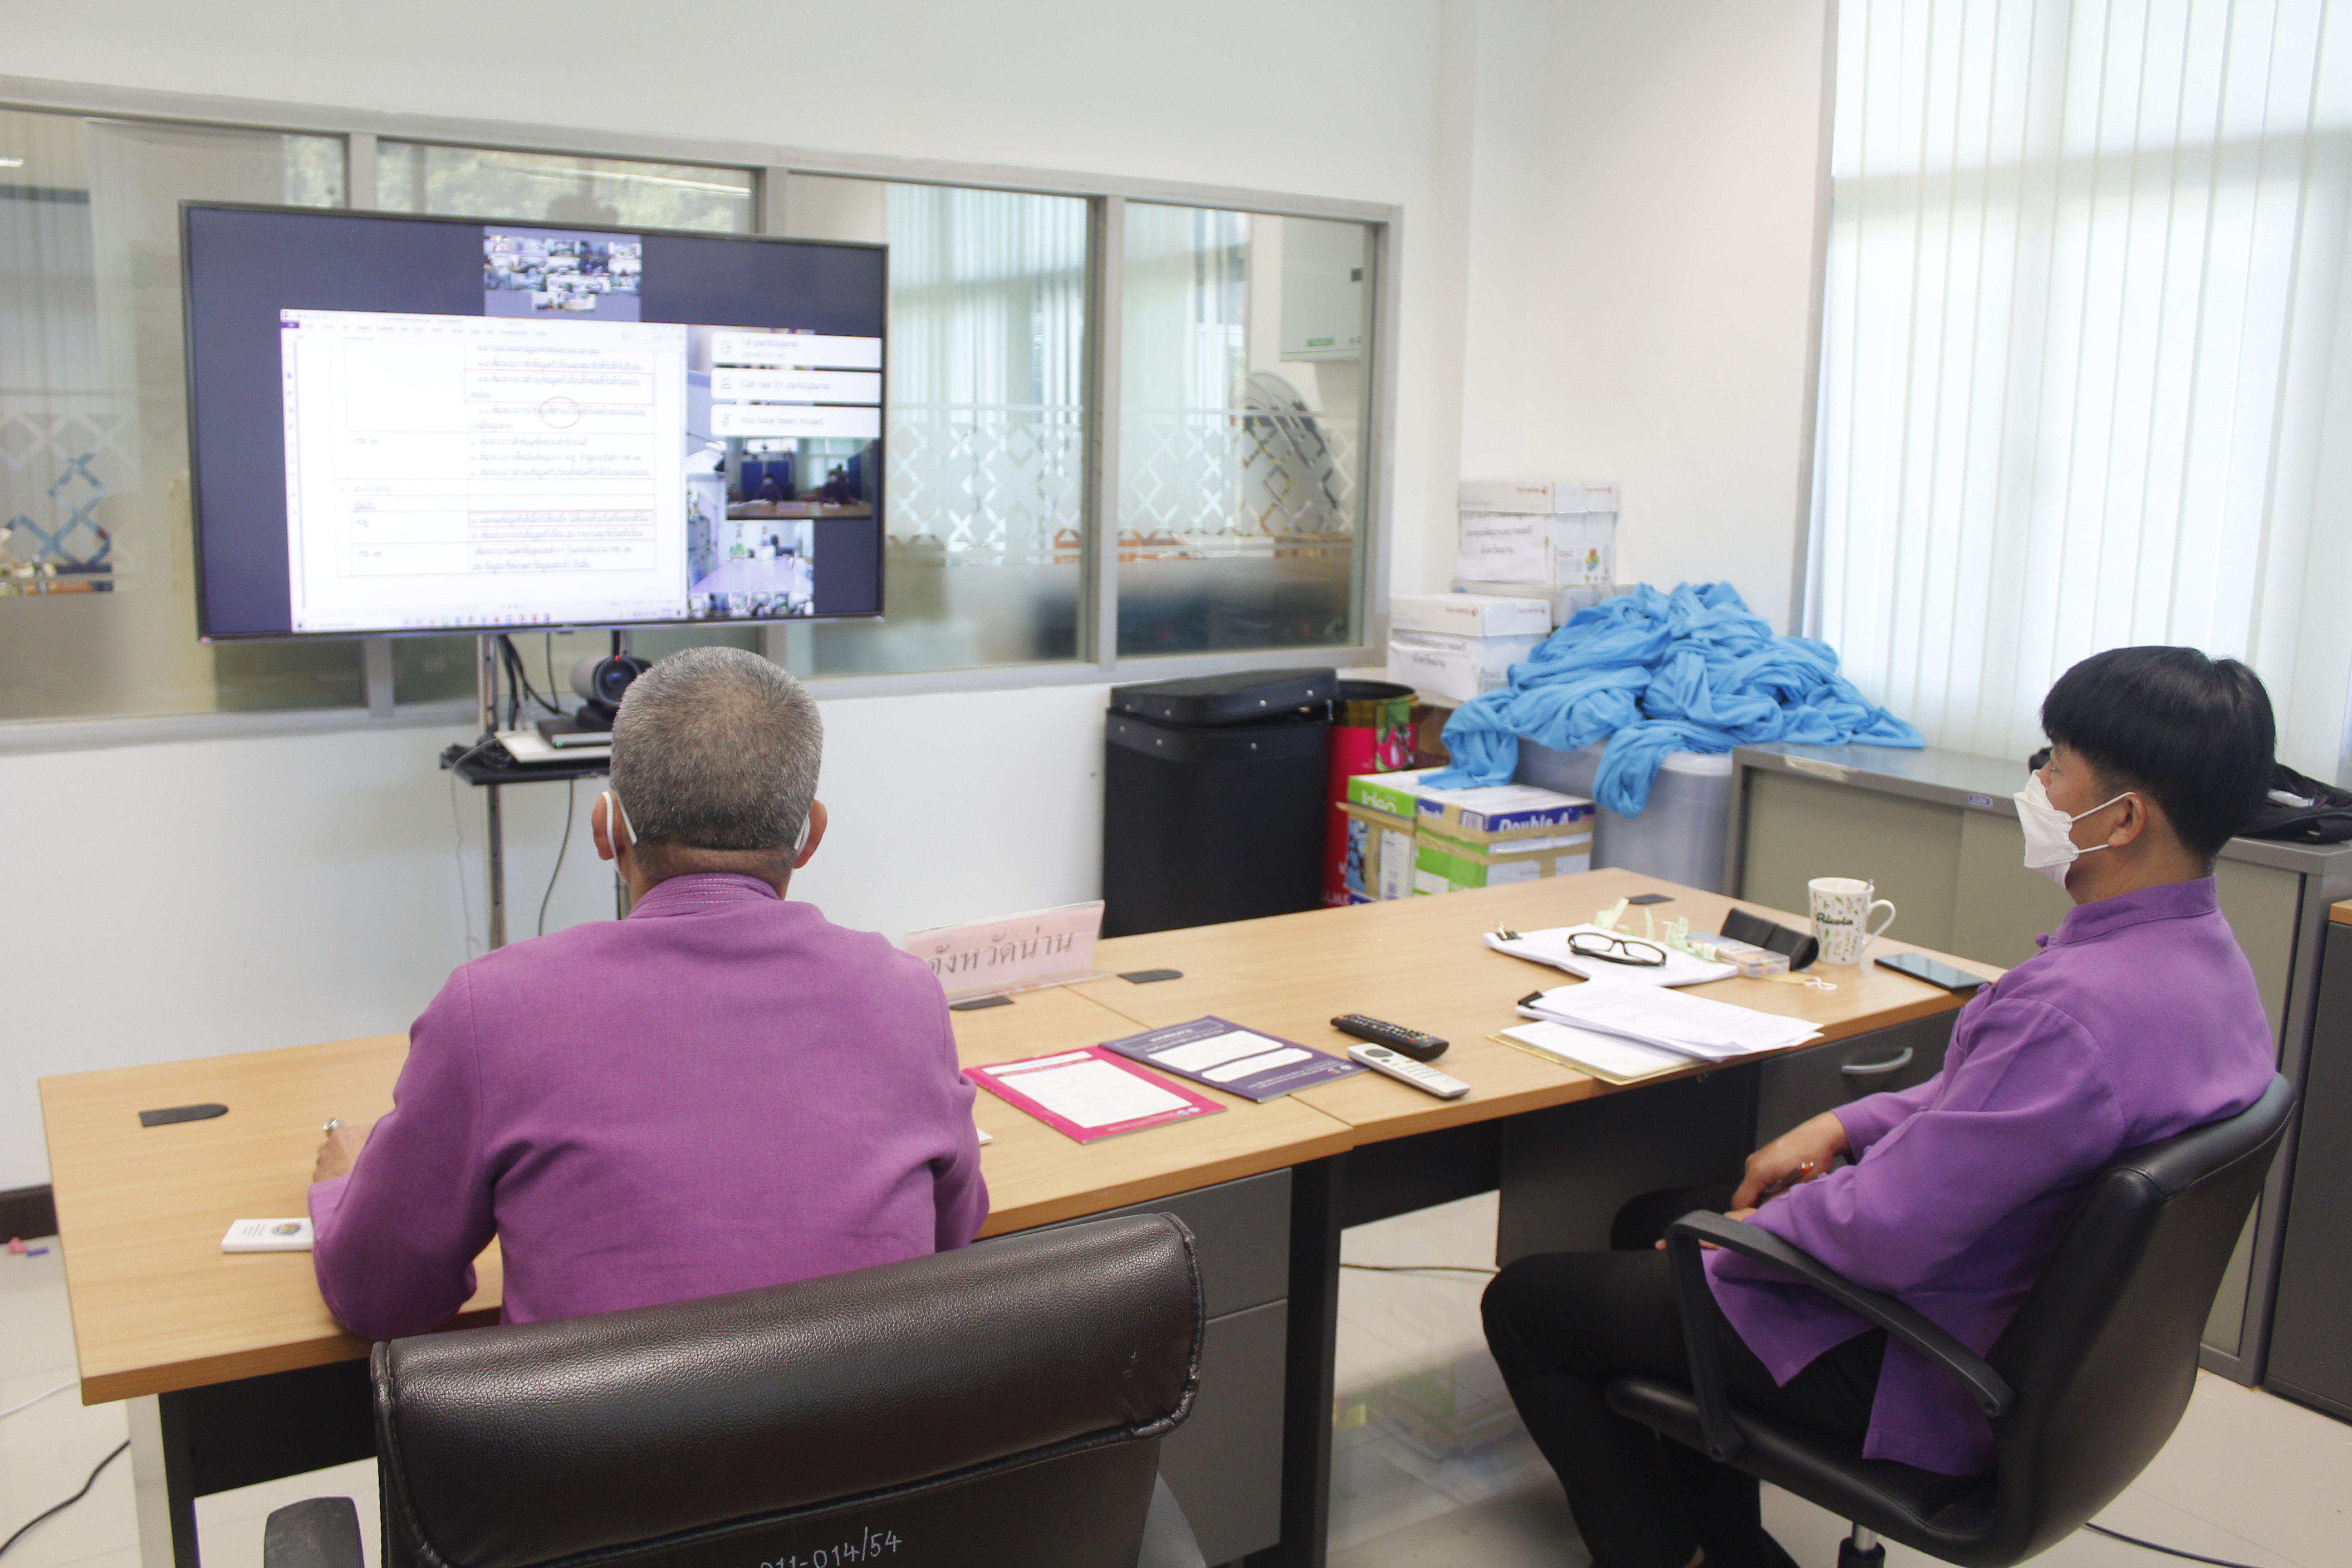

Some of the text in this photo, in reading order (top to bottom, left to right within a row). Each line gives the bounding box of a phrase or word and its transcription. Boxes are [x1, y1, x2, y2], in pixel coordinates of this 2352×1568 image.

[754, 339, 799, 348] participants
[740, 379, 755, 388] Call
[758, 380, 771, 388] has
[785, 381, 830, 390] participants
[741, 416, 755, 425] You
[757, 416, 775, 425] have
[777, 416, 797, 425] been
[1816, 912, 1853, 925] Ricola
[928, 925, 1074, 977] จังหวัดน่าน
